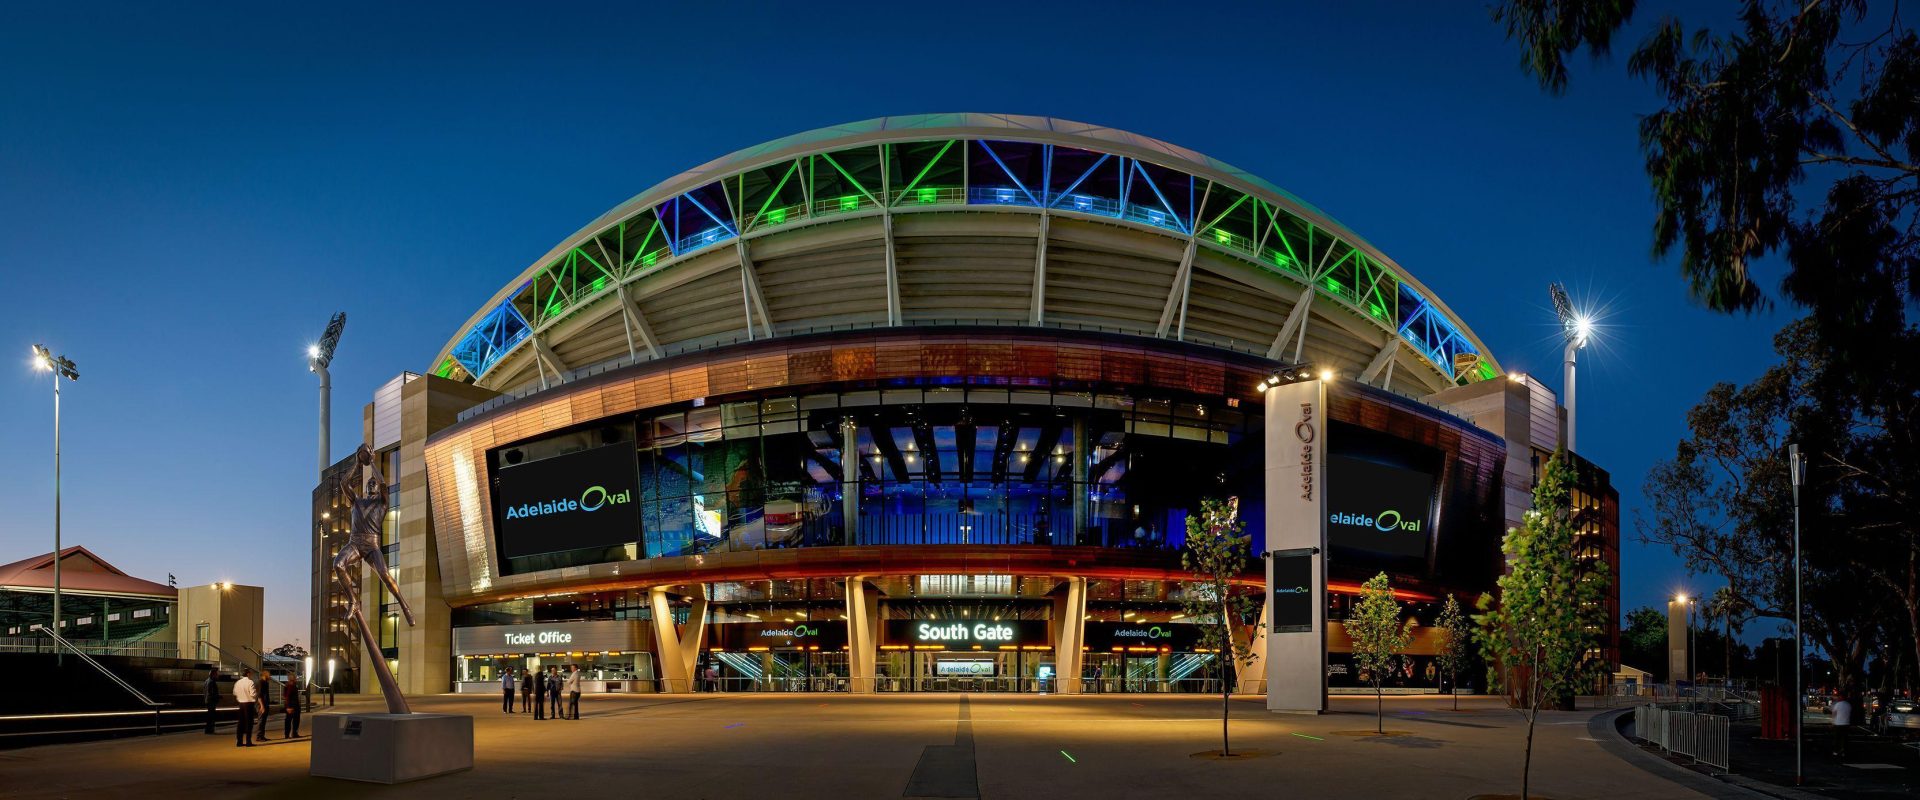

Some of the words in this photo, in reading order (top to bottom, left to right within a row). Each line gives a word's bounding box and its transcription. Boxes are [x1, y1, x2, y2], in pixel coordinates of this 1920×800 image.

[1295, 402, 1314, 444] Oval
[1301, 445, 1312, 501] Adelaide
[506, 499, 577, 519] Adelaide
[580, 485, 631, 512] Oval
[1329, 511, 1374, 527] elaide
[1375, 509, 1421, 532] Oval
[505, 633, 535, 645] Ticket
[539, 632, 572, 644] Office
[760, 628, 794, 637] Adelaide
[794, 624, 818, 638] Oval
[918, 623, 969, 641] South
[973, 624, 1014, 641] Gate
[1114, 628, 1148, 638] Adelaide
[1148, 626, 1172, 639] Oval
